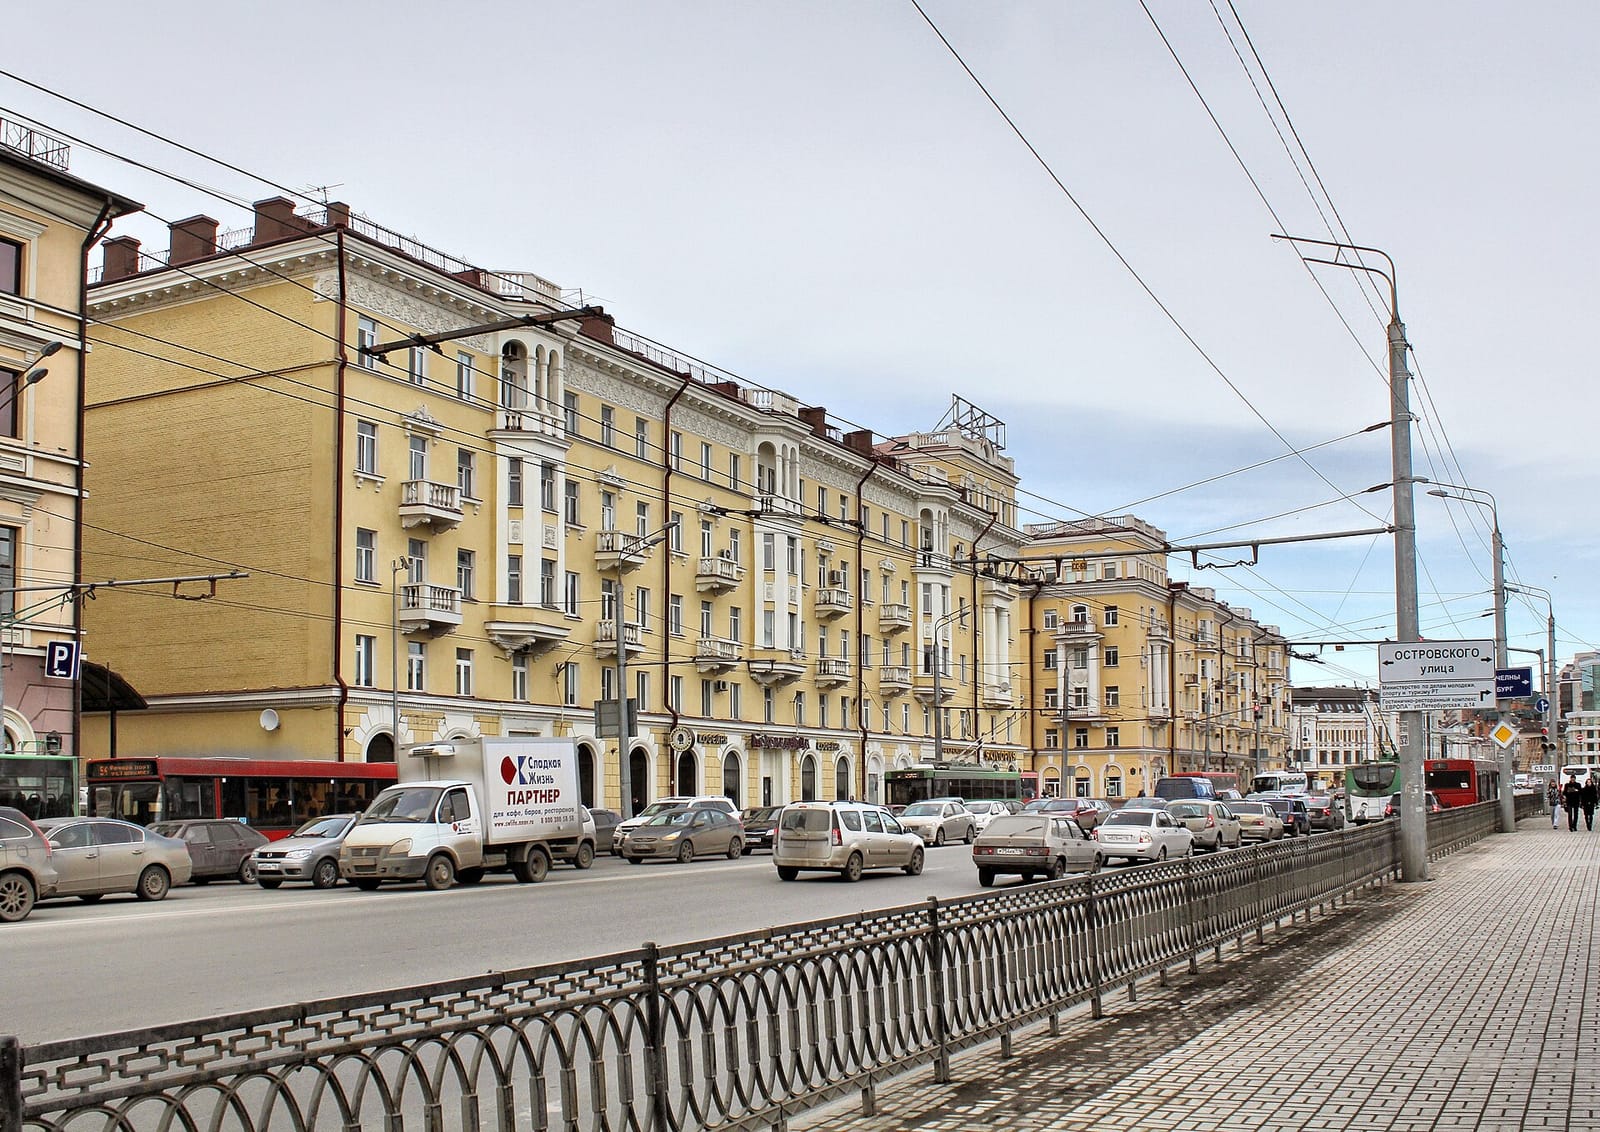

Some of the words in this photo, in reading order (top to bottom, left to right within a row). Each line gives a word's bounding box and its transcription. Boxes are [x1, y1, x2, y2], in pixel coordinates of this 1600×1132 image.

[53, 645, 69, 669] P
[1394, 647, 1480, 661] ОСТРОВСКОГО
[1420, 664, 1455, 675] улица
[528, 756, 561, 770] Сладкая
[528, 772, 554, 784] Жизнь
[507, 789, 560, 805] ПАРТНЕР
[506, 810, 523, 818] кафе,
[524, 808, 543, 816] баров,
[544, 807, 575, 815] ресторанов
